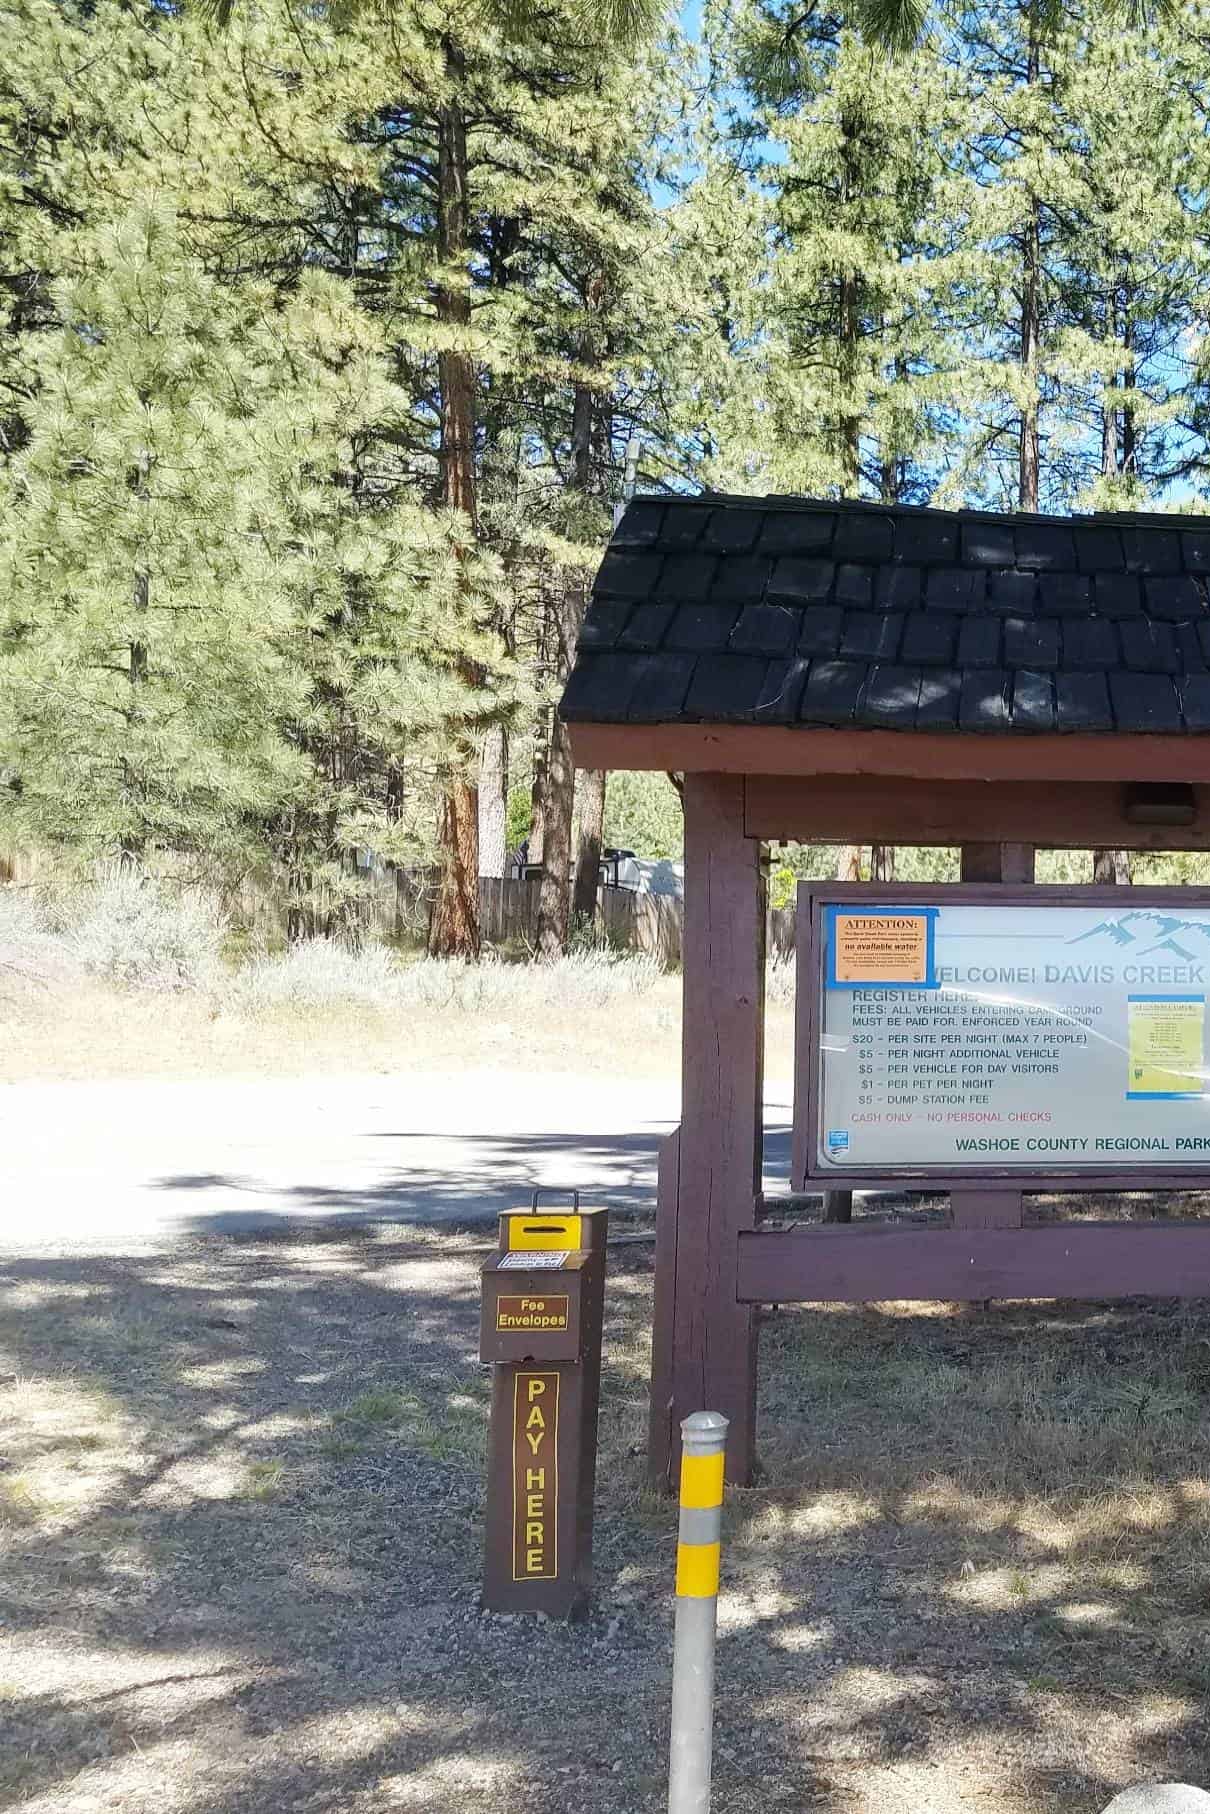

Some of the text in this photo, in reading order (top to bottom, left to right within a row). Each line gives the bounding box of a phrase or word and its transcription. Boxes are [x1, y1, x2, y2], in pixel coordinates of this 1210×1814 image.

[845, 919, 918, 929] ATTENTION:
[857, 942, 893, 951] available
[1045, 967, 1114, 983] DAVIS
[1123, 966, 1204, 984] CREEK
[853, 990, 928, 1002] REGISTER
[853, 1004, 887, 1014] FEES:
[892, 1005, 912, 1014] ALL
[916, 1005, 967, 1015] VEHICLES
[971, 1005, 1024, 1015] ENTERING
[853, 1017, 882, 1026] MUST
[887, 1017, 901, 1026] BE
[905, 1017, 928, 1026] PAID
[962, 1017, 1019, 1026] ENFORCED
[1025, 1017, 1051, 1026] YEAR
[852, 1034, 873, 1044] $20
[888, 1034, 908, 1044] PER
[913, 1034, 937, 1044] SITE
[941, 1034, 961, 1044] PER
[966, 1034, 998, 1044] NIGHT
[1002, 1034, 1029, 1045] (MAX
[1033, 1034, 1040, 1044] 7
[1043, 1033, 1087, 1045] PEOPLE)
[887, 1049, 908, 1059] PER
[913, 1049, 945, 1059] NIGHT
[949, 1049, 1012, 1059] ADDITIONAL
[1015, 1049, 1060, 1059] VEHICLE
[887, 1064, 908, 1074] PER
[913, 1064, 957, 1074] VEHICLE
[961, 1064, 983, 1074] FOR
[987, 1064, 1007, 1074] DAY
[1011, 1064, 1059, 1074] VISITORS
[862, 1079, 873, 1089] $1
[887, 1079, 908, 1089] PER
[912, 1079, 933, 1089] PET
[936, 1079, 957, 1089] PER
[962, 1079, 994, 1089] NIGHT
[887, 1095, 918, 1104] DUMP
[922, 1095, 965, 1104] STATION
[969, 1095, 990, 1104] FEE
[851, 1112, 881, 1122] CASH
[885, 1112, 913, 1122] ONLY
[927, 1112, 943, 1122] NO
[947, 1112, 1004, 1122] PERSONAL
[1007, 1112, 1051, 1122] CHECKS
[955, 1138, 1020, 1151] WASHOE
[1026, 1138, 1089, 1151] COUNTY
[1095, 1137, 1170, 1150] REGIONAL
[521, 1299, 545, 1311] Fee
[499, 1314, 566, 1327] Envelopes
[526, 1379, 546, 1571] PAY HERE
